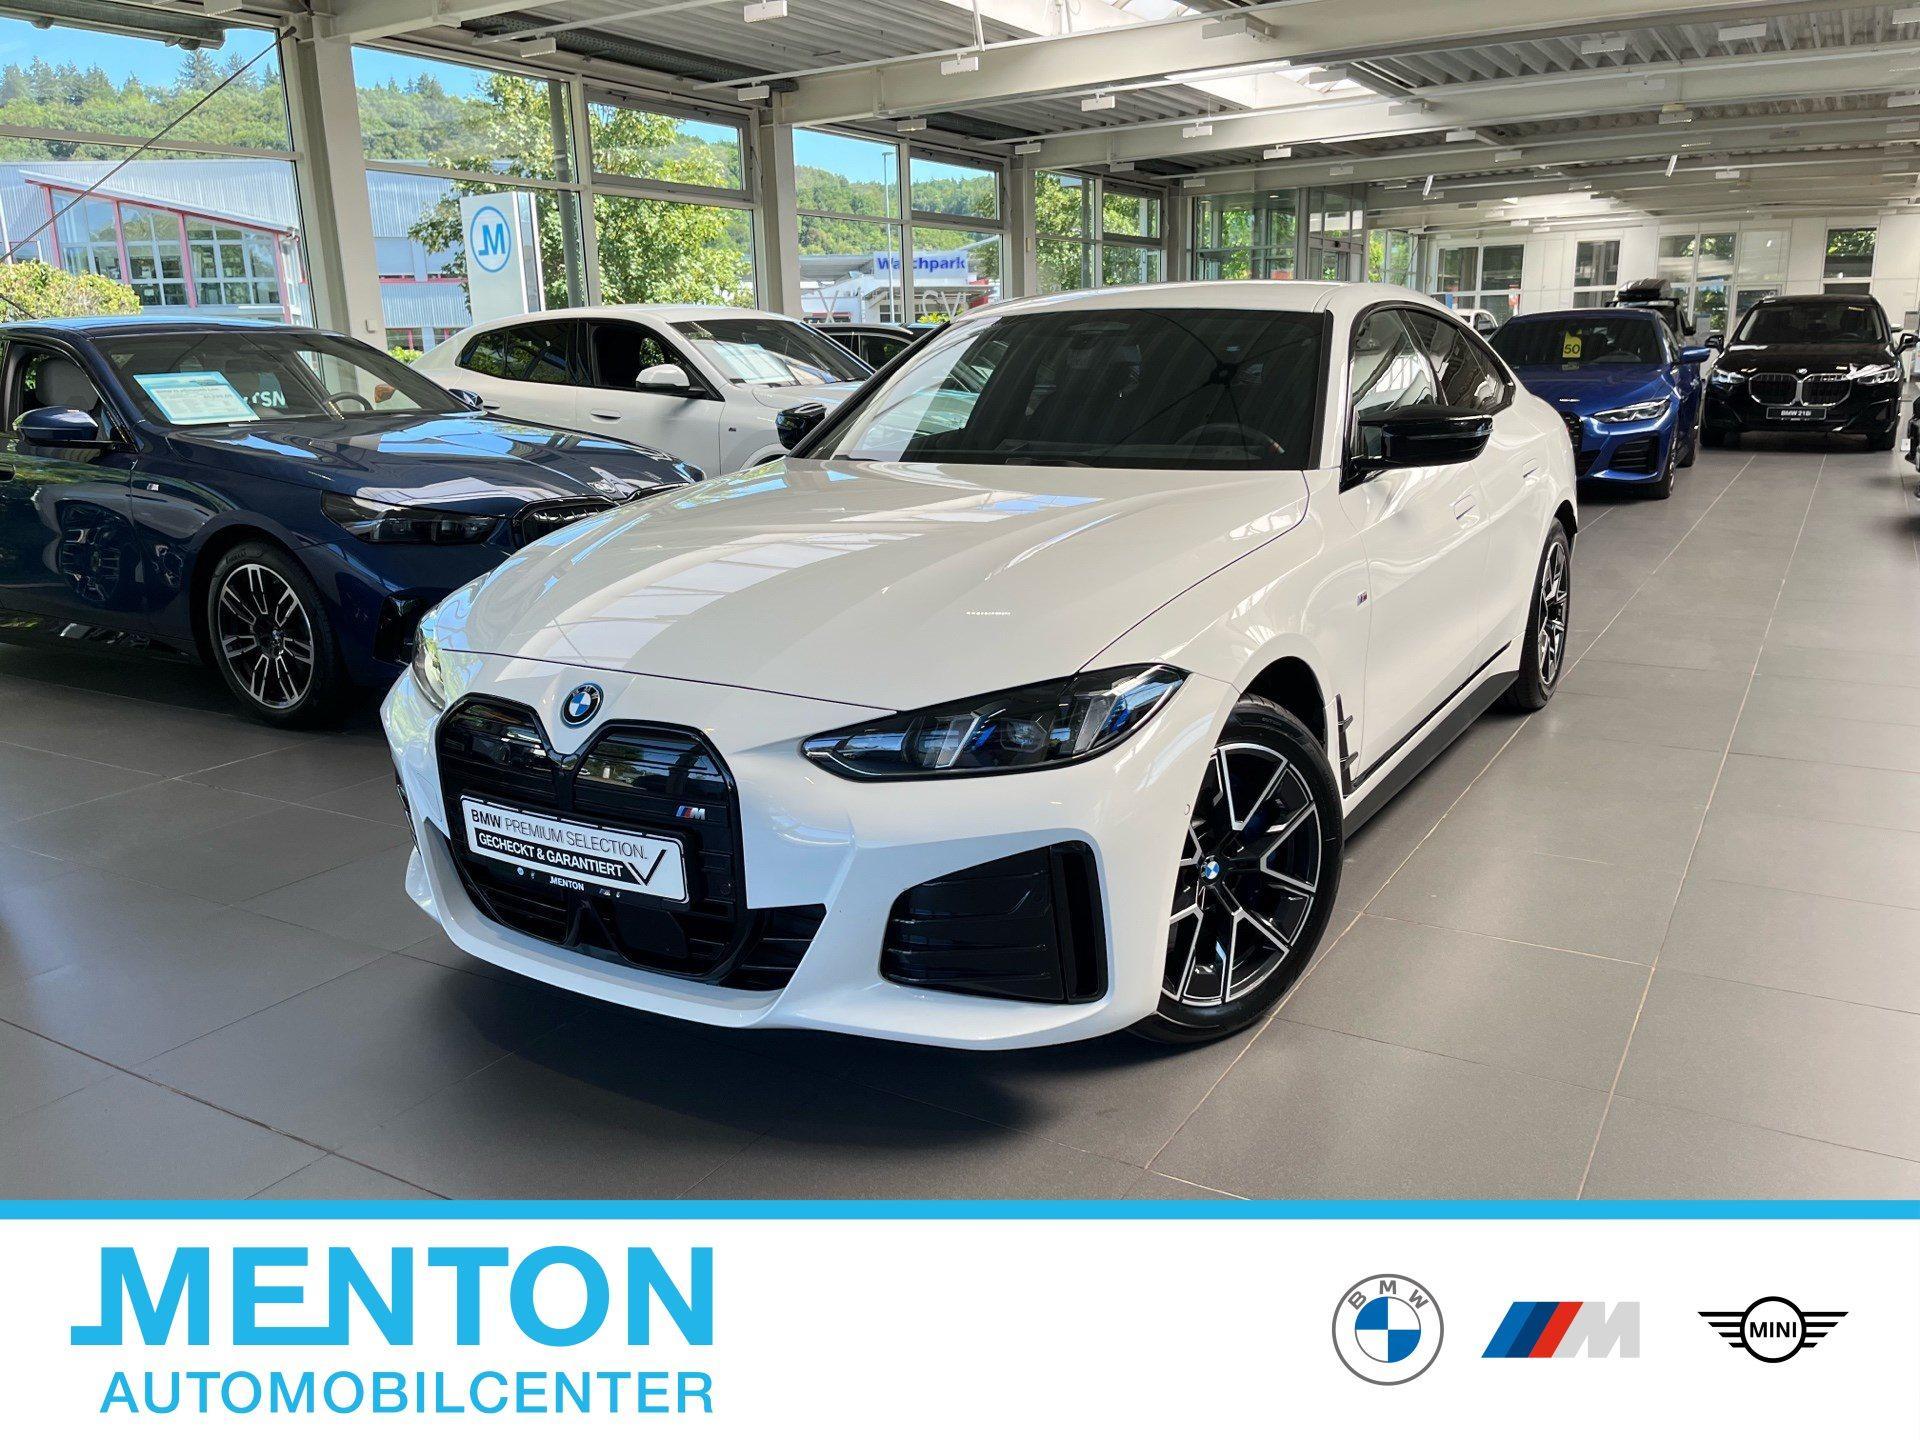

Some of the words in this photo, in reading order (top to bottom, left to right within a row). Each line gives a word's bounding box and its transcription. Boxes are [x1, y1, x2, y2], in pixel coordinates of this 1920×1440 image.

[878, 257, 965, 272] Wachpark
[1564, 344, 1580, 354] 50
[471, 809, 501, 829] BMW
[505, 817, 564, 844] PREMIUM
[478, 831, 535, 858] GECHECKT
[536, 848, 545, 861] &
[546, 850, 624, 877] GARANTIERT
